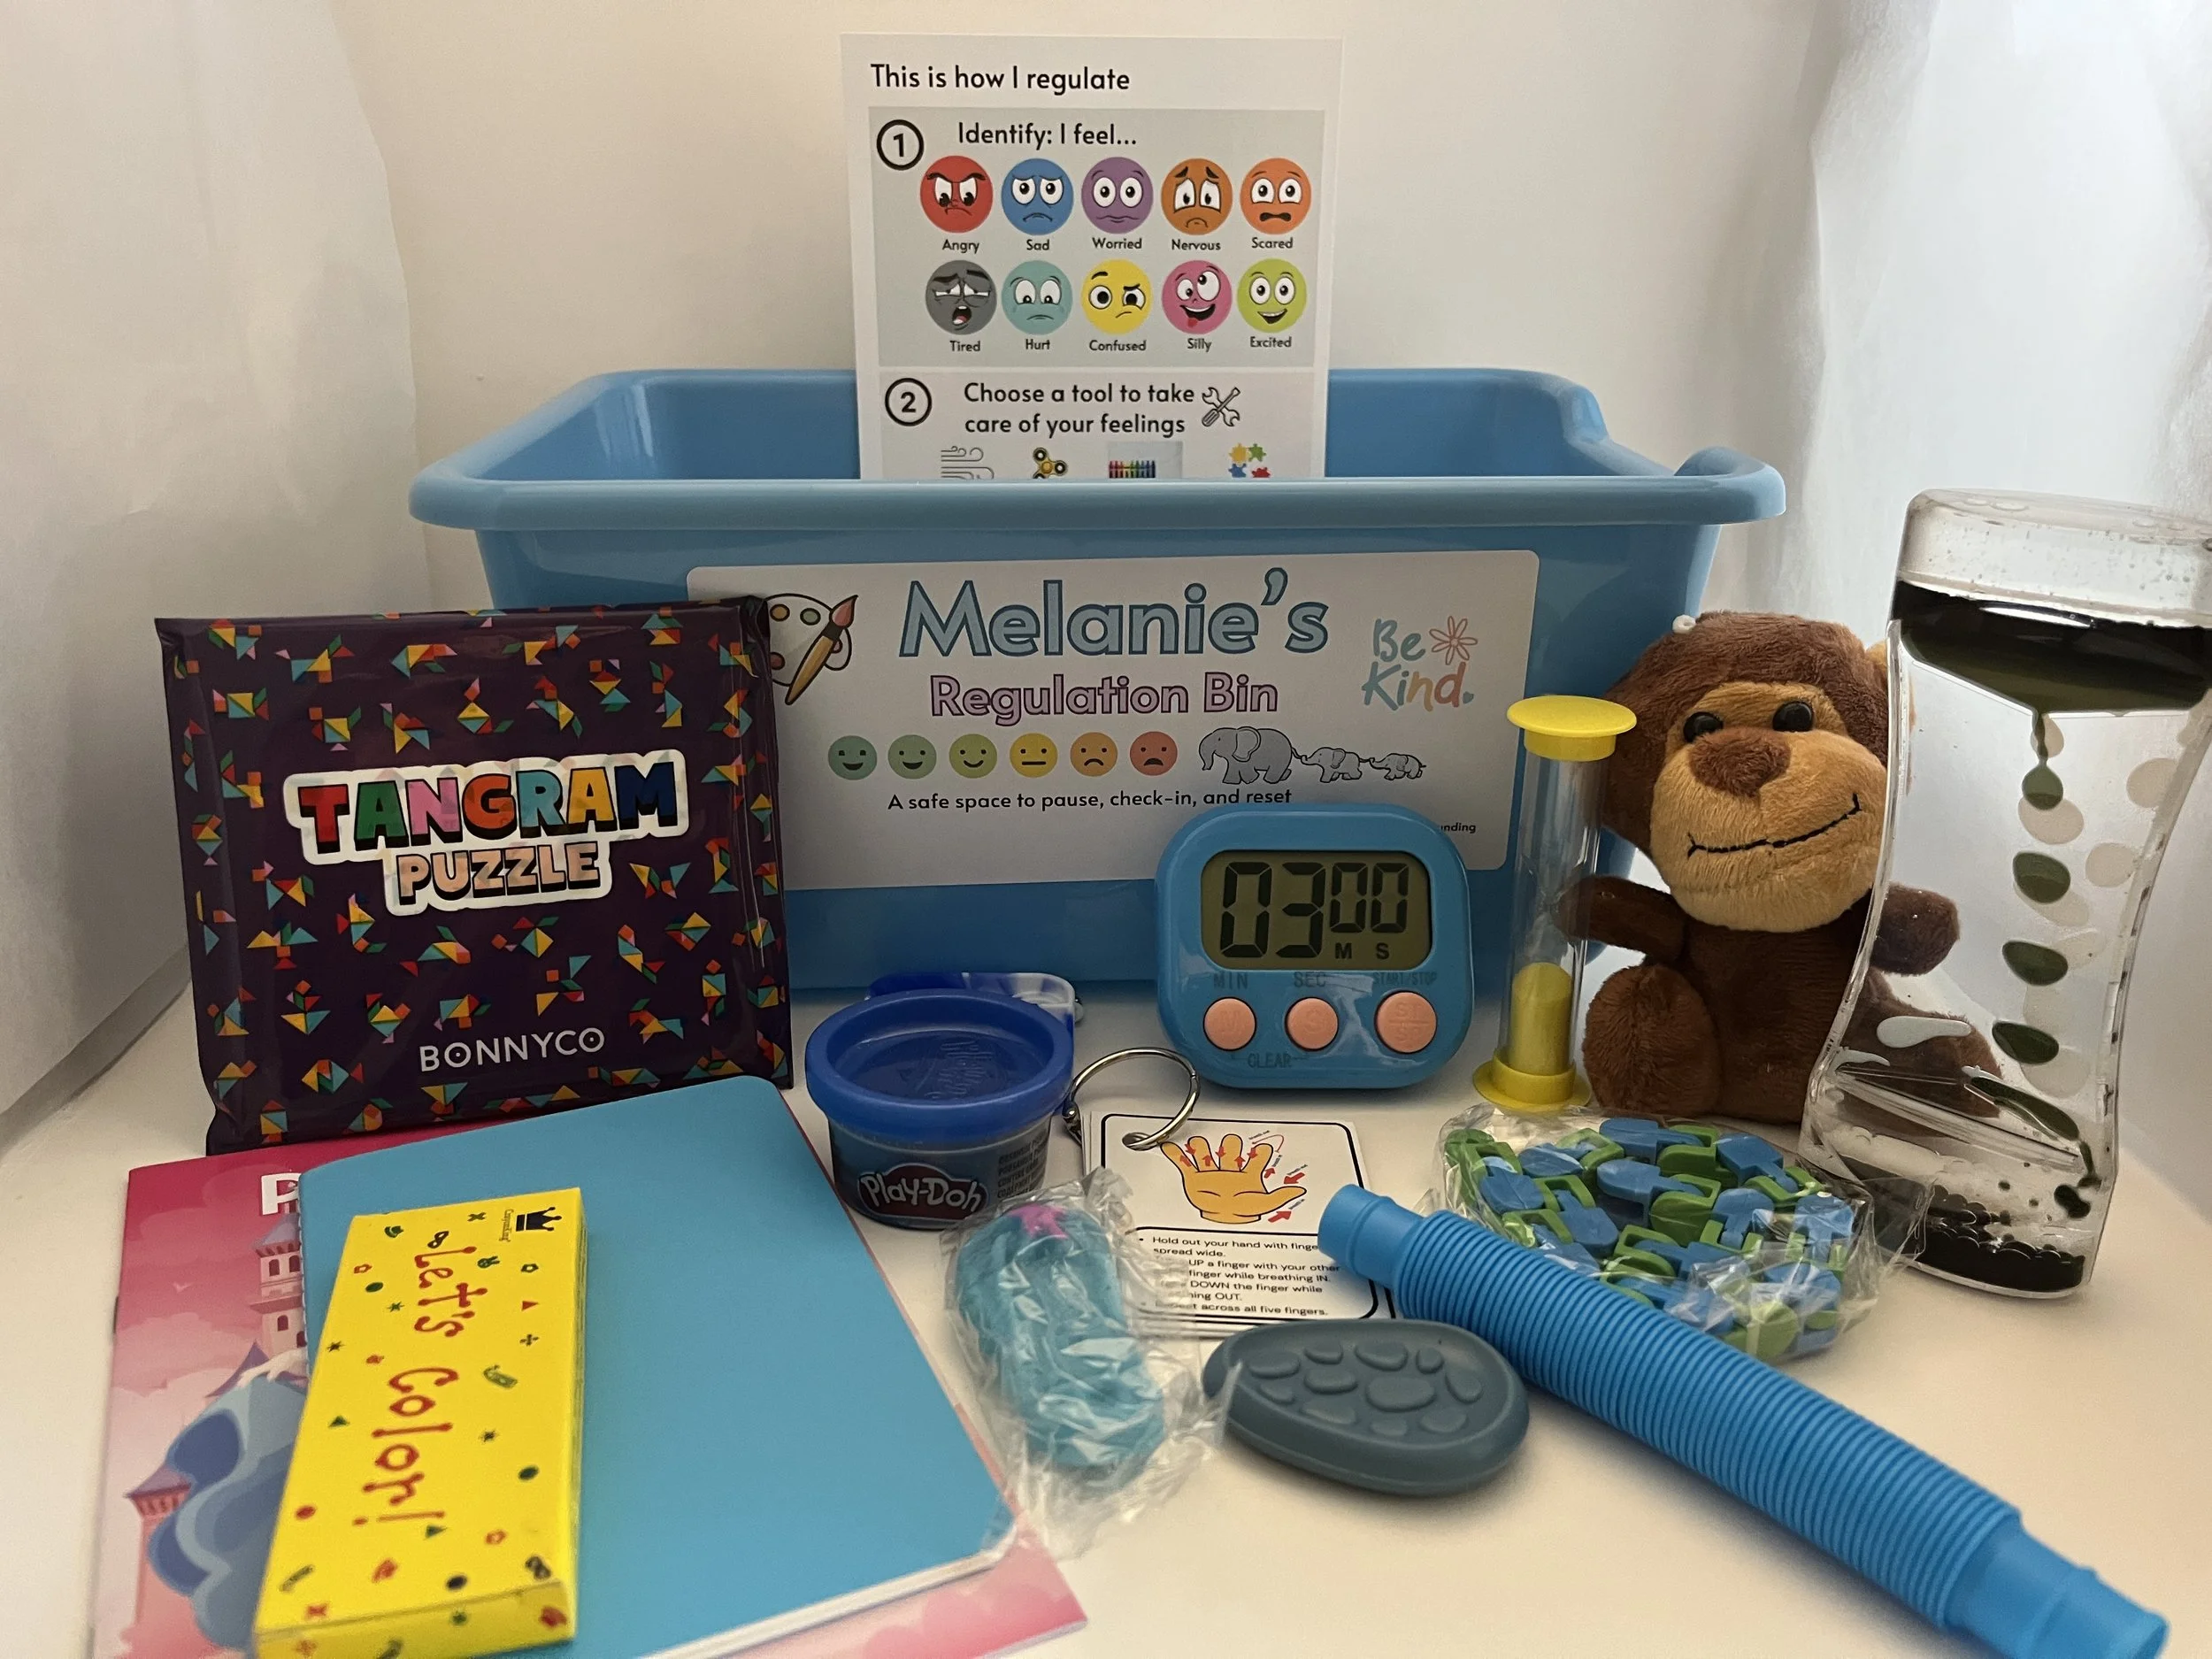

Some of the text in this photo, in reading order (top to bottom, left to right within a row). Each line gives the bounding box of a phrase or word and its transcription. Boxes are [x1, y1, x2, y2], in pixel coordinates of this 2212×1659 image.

[871, 63, 1131, 96] This is how I regulate
[893, 133, 905, 157] 1
[958, 121, 1137, 150] Identify: I feel...
[941, 236, 1294, 256] Angry Sad Worried Nervous Scared
[949, 336, 1292, 352] Tired Hurt Confused Silly Excited
[900, 391, 918, 413] 2
[964, 382, 1195, 403] Choose a tool to take
[964, 413, 1186, 438] care of your feelings
[898, 566, 1331, 657] Melanie's
[1373, 618, 1425, 662] Be
[930, 670, 1279, 727] Regulation Bin
[297, 760, 677, 854] TANGRAM
[887, 789, 1292, 812] A safe space to pause, check-in, and reset
[396, 841, 600, 905] PUZZLE
[1335, 942, 1390, 959] M S
[1213, 973, 1248, 989] MIN
[1294, 972, 1327, 987] SEC
[419, 1027, 605, 1072] BONNYCO
[1248, 1053, 1292, 1068] CLEAR
[858, 1172, 981, 1212] Play-Doh
[1291, 1242, 1318, 1252] finge
[1189, 1270, 1222, 1279] finger
[1258, 1273, 1313, 1283] breathing
[1217, 1261, 1250, 1270] finger
[413, 1246, 488, 1338] Let's
[1190, 1280, 1230, 1289] DOWN
[1256, 1284, 1288, 1293] finger
[1285, 1307, 1328, 1316] fingers.
[352, 1366, 460, 1527] Color!
